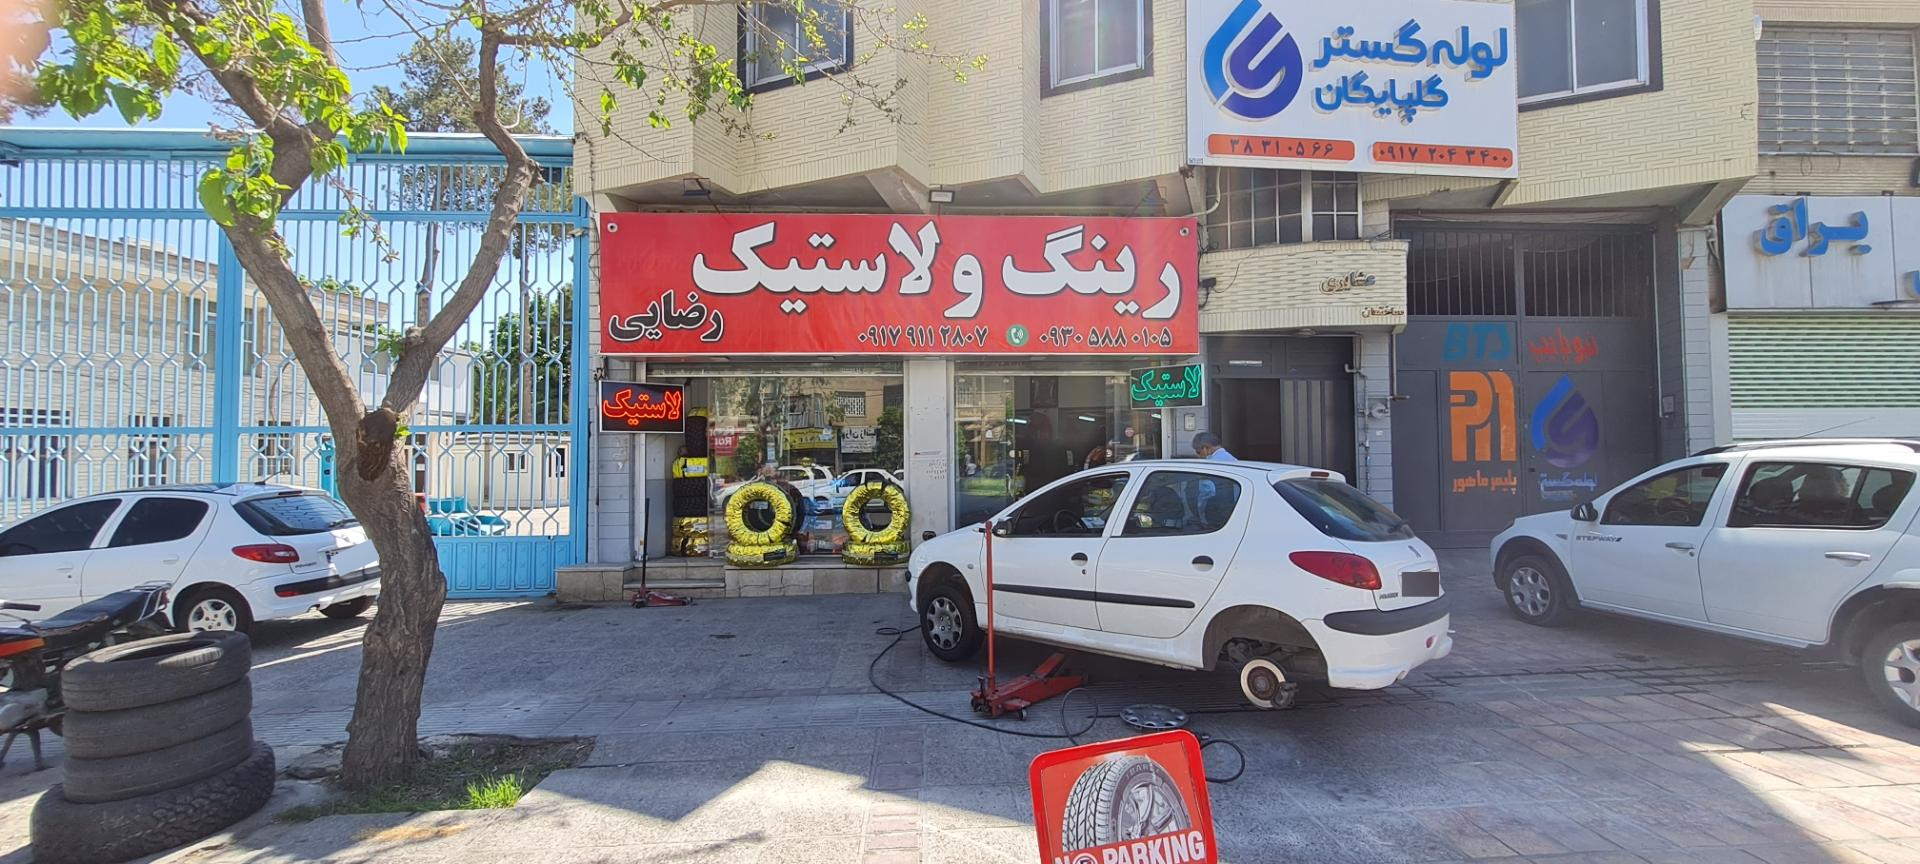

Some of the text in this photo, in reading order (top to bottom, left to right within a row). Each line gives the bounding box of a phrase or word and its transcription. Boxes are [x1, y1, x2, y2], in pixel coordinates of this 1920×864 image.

[1312, 18, 1508, 79] لوله گستر
[1314, 70, 1449, 123] گلپایگان
[1379, 144, 1508, 163] ۰۹۱۷ ۲۰۴ ۳۴۰۰
[1756, 197, 1873, 256] یراق
[691, 220, 941, 314] لاستیک
[1001, 224, 1181, 319] رینگ
[608, 289, 725, 342] رضایی
[857, 325, 989, 347] ۰۹۱۷ ۹۱۱ ۲۸۰۷
[1039, 325, 1173, 347] ۰۹۳۰ ۵۸۸ ۰۱۰۵
[1130, 364, 1201, 407] لاستیک
[603, 389, 682, 426] لاستیک
[1452, 469, 1518, 495] پلیمر ماهور
[1101, 830, 1206, 864] PARKING
